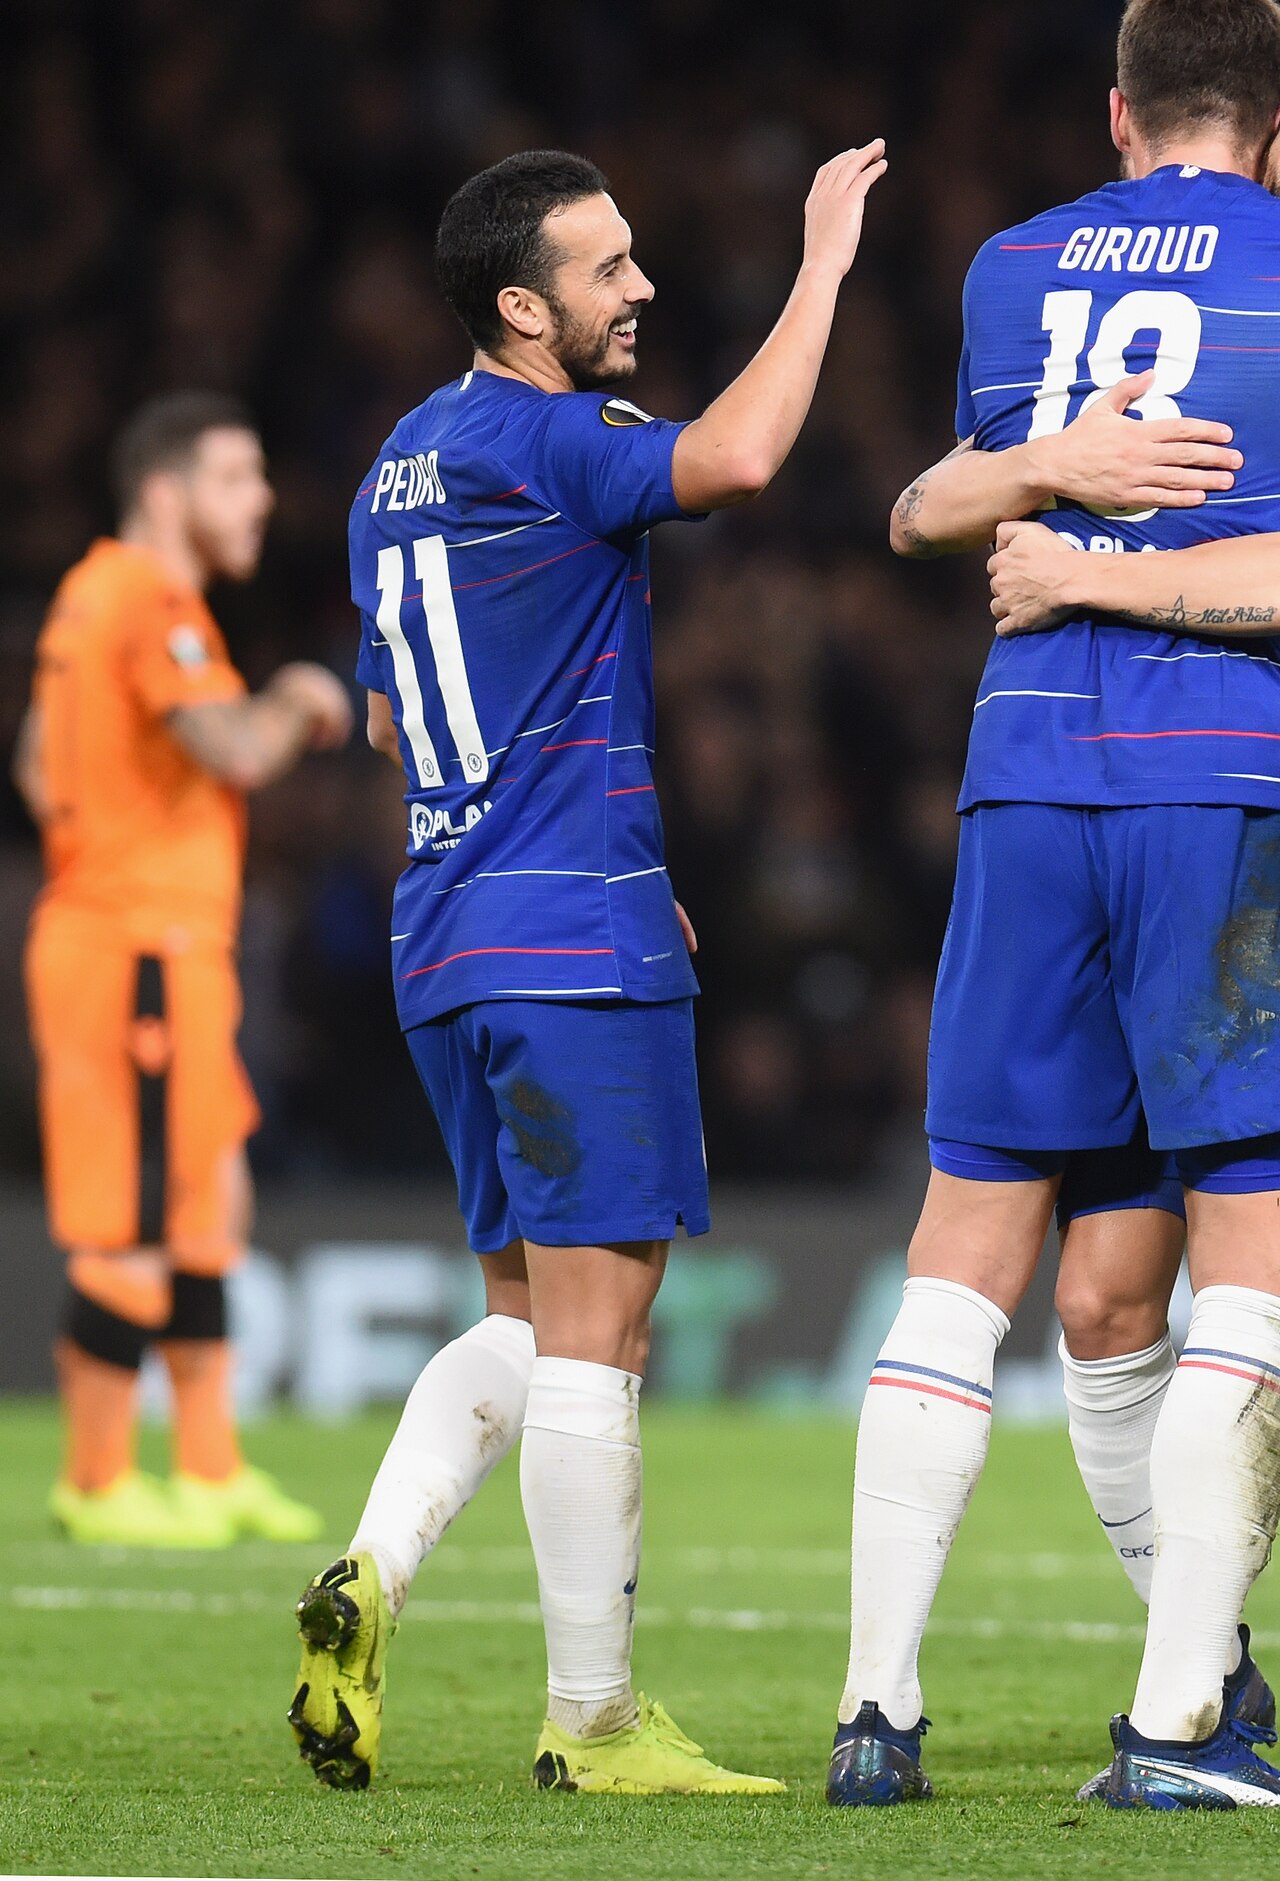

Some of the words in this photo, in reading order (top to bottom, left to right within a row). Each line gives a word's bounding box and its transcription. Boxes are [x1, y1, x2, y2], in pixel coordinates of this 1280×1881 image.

[1057, 225, 1220, 273] GIROUD
[1026, 289, 1202, 522] 18
[370, 449, 447, 514] PEDRO
[375, 534, 488, 788] 11
[1119, 1543, 1155, 1559] CFC
